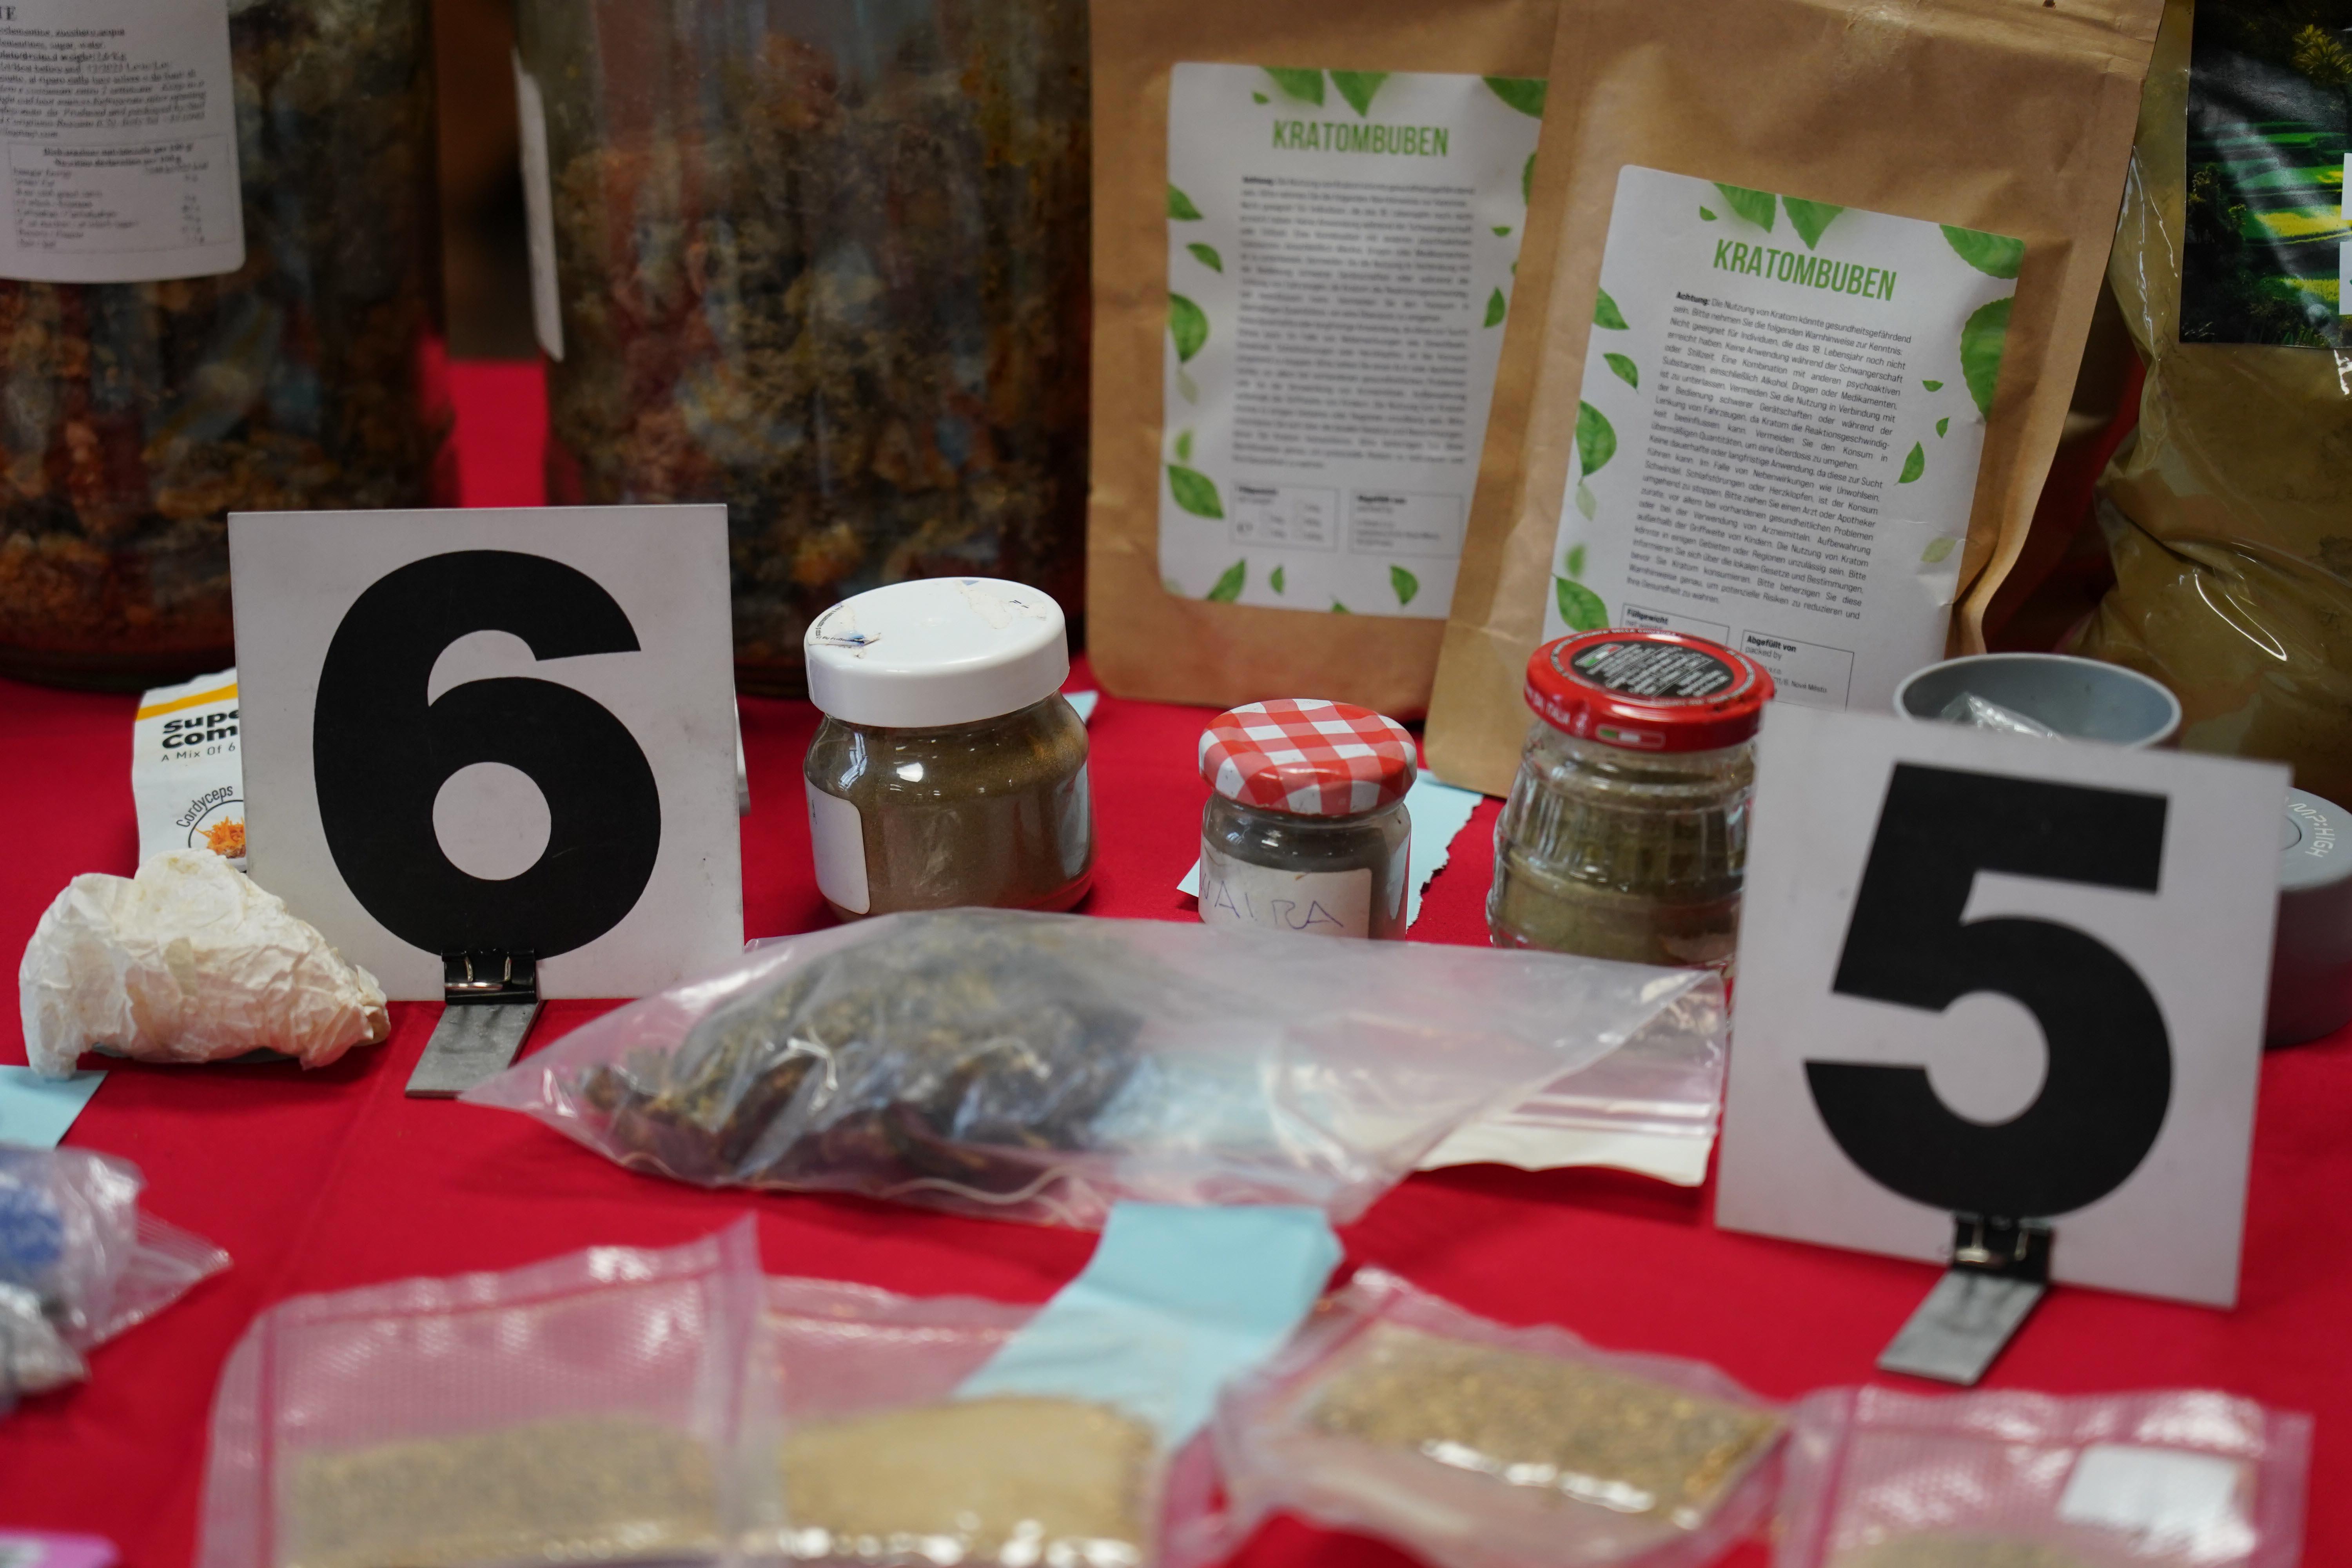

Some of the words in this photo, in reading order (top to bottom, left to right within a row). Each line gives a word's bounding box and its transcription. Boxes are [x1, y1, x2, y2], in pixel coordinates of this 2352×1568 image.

[1274, 120, 1448, 156] KRATOMBUBEN
[1713, 239, 1896, 301] KRATOMBUBEN
[1798, 315, 1824, 327] könnte
[1825, 322, 1911, 343] gesundheitsgefährdend
[1795, 342, 1809, 352] das
[1824, 347, 1864, 362] Lebensjahr
[1866, 357, 1884, 366] noch
[1886, 360, 1906, 370] nicht
[1805, 330, 1855, 347] Warnhinweise
[1869, 342, 1902, 356] Kenntnis:
[1791, 356, 1824, 368] während
[1824, 361, 1837, 370] der
[1838, 363, 1903, 383] Schwangerschaft
[1793, 370, 1806, 378] mit
[1811, 374, 1841, 385] anderen
[1846, 380, 1900, 396] psychoaktiven
[1792, 381, 1818, 394] Drogen
[1821, 389, 1838, 397] oder
[1760, 403, 1812, 420] Gerätschaften
[1818, 416, 1835, 425] oder
[1842, 420, 1874, 432] während
[1880, 427, 1893, 435] der
[1783, 394, 1794, 403] die
[1796, 396, 1828, 411] Nutzung
[1829, 403, 1836, 411] in
[1839, 404, 1880, 421] Verbindung
[1882, 414, 1895, 423] mit
[1756, 429, 1794, 444] Vermeiden
[1802, 438, 1813, 448] Sie
[1821, 443, 1835, 451] den
[1843, 446, 1873, 459] Konsum
[1791, 423, 1802, 432] die
[1805, 425, 1889, 450] Reaktionsgeschwindig-
[1775, 445, 1811, 461] Überdosis
[1753, 469, 1815, 488] Nebenwirkungen
[1817, 469, 1826, 477] da
[1827, 471, 1847, 481] diese
[1861, 477, 1883, 488] Sucht
[1768, 499, 1780, 508] Sie
[1780, 503, 1801, 512] einen
[1802, 506, 1818, 516] Arzt
[1819, 511, 1836, 519] oder
[1837, 513, 1876, 527] Apotheker
[1818, 496, 1828, 505] ist
[1831, 499, 1844, 508] der
[1848, 502, 1878, 515] Konsum
[1769, 514, 1831, 532] gesundheitlichen
[1834, 526, 1873, 541] Problemen
[1777, 541, 1788, 551] Die
[1791, 544, 1822, 559] Nutzung
[1841, 555, 1868, 567] Kratom
[1817, 536, 1871, 556] Aufbewahrung
[1752, 549, 1786, 563] Regionen
[1788, 559, 1826, 573] unzulässig
[1848, 570, 1866, 581] Bitte
[1760, 564, 1790, 578] Gesetze
[1791, 573, 1806, 582] und
[1757, 577, 1775, 589] Bitte
[1780, 582, 1820, 598] beherzigen
[1826, 592, 1837, 602] Sie
[1842, 596, 1862, 606] diese
[1763, 592, 1789, 604] Risiken
[1803, 603, 1842, 615] reduzieren
[1745, 647, 1771, 657] packed
[1773, 650, 1782, 661] by
[1747, 635, 1781, 648] Abgefüllt
[1783, 644, 1797, 652] von
[162, 724, 238, 749] Com
[176, 750, 200, 759] Mix
[207, 746, 221, 756] Of
[313, 550, 661, 960] 6
[176, 785, 233, 828] Cordyceps
[2285, 797, 2335, 857] MP:HIGH
[1803, 761, 2173, 1219] 5
